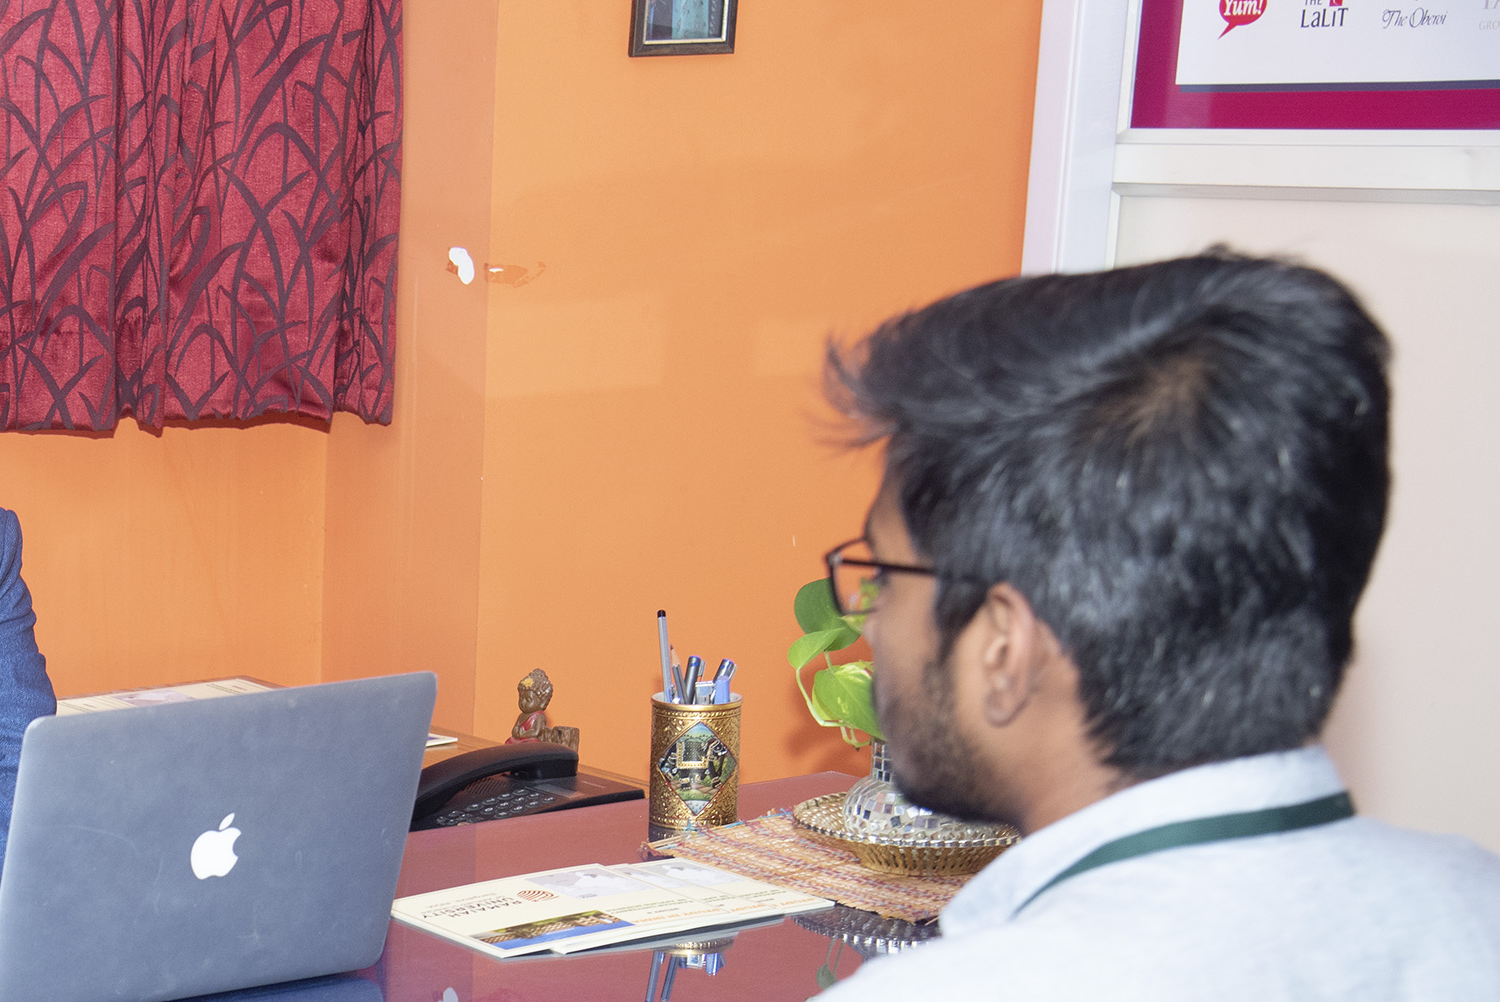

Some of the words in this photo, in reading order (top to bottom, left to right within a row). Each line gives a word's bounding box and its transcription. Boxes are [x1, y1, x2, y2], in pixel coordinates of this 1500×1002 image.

[1224, 0, 1263, 16] Yum!
[1382, 9, 1408, 29] The
[448, 901, 521, 918] RAMAIAH
